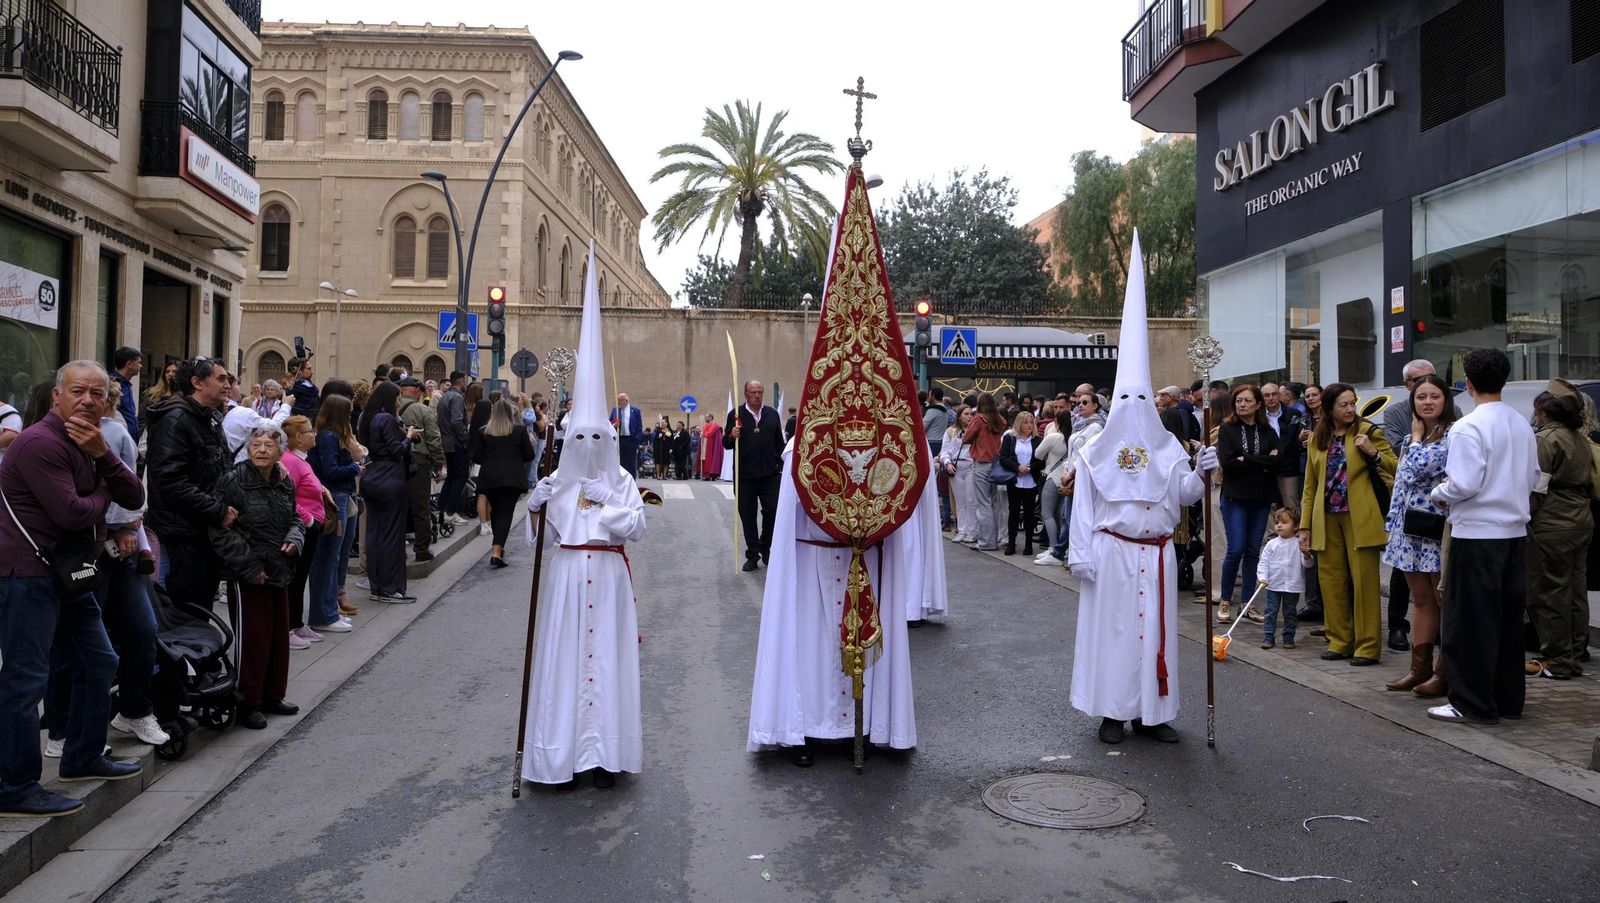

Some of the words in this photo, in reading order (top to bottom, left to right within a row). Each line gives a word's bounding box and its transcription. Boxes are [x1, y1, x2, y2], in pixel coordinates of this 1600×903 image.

[1214, 97, 1319, 192] SALON
[1321, 63, 1395, 133] GIL
[5, 179, 29, 200] LUIS
[215, 161, 258, 206] Manpower
[1245, 194, 1268, 216] THE
[1269, 167, 1329, 206] ORGANIC
[1331, 151, 1363, 180] WAY
[41, 287, 53, 304] 50
[71, 568, 95, 580] PUMA
